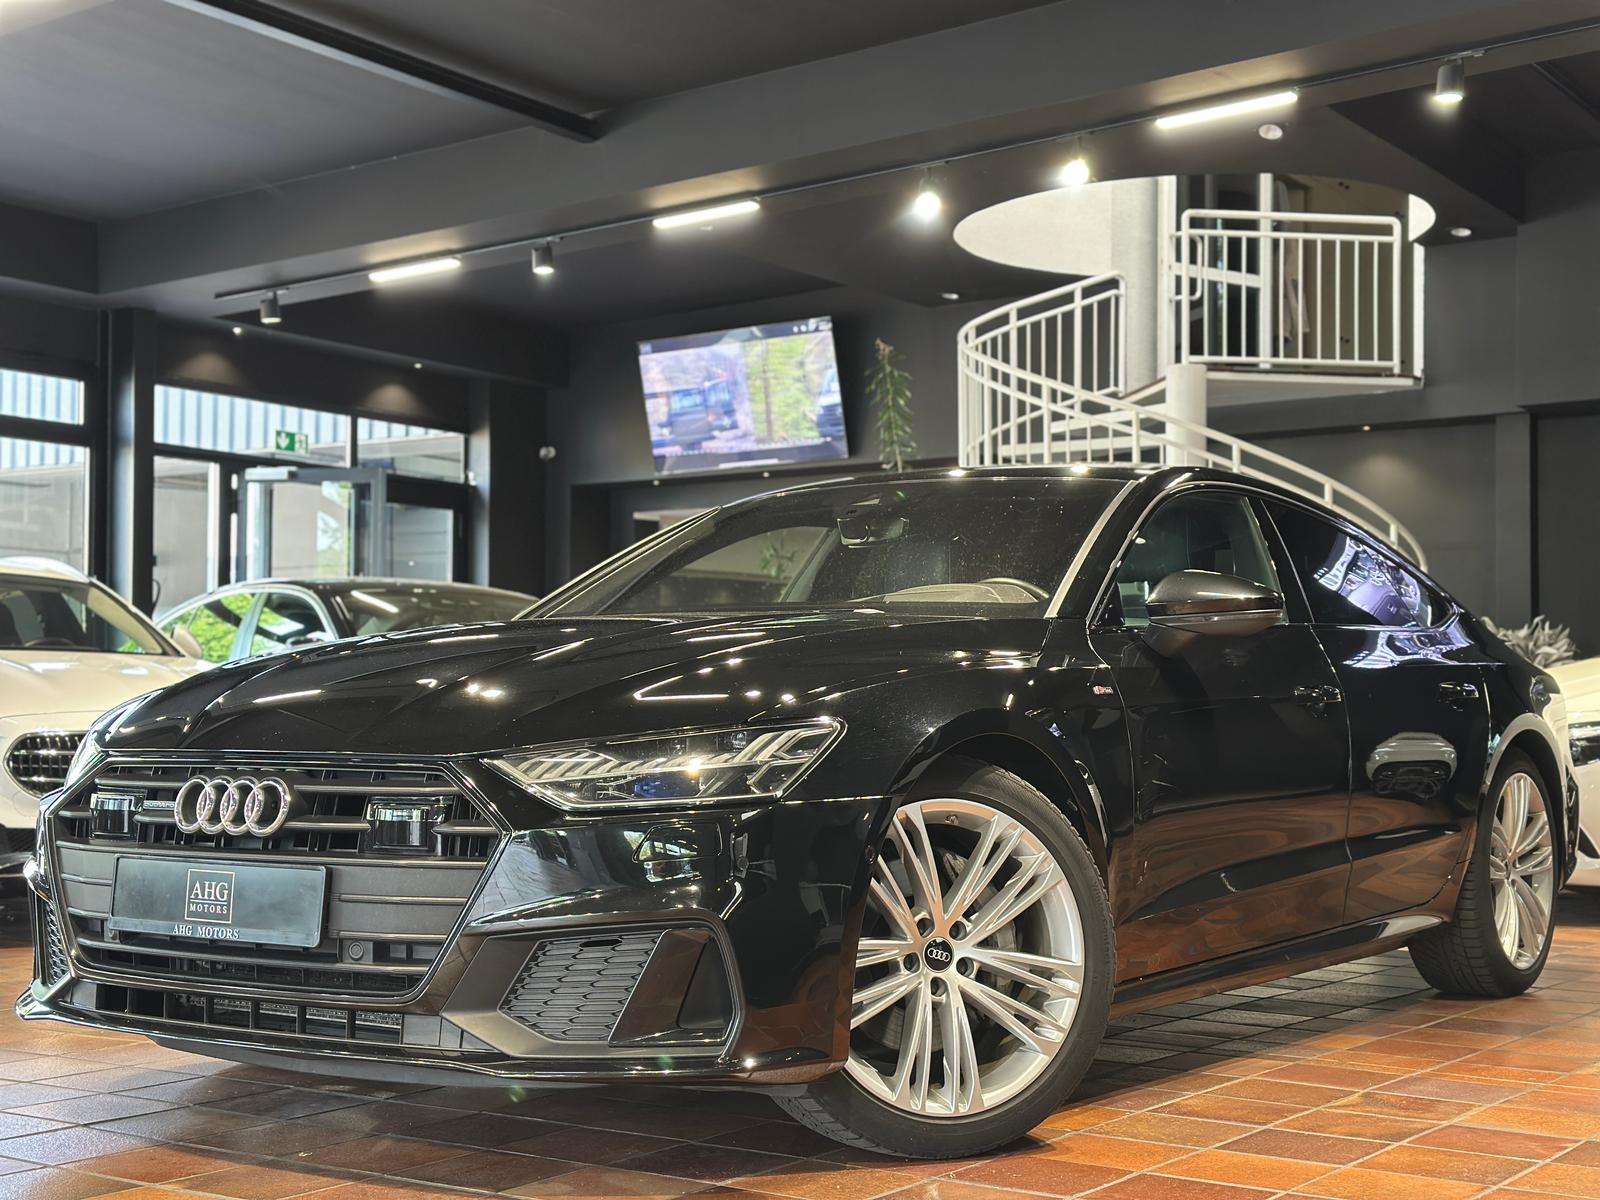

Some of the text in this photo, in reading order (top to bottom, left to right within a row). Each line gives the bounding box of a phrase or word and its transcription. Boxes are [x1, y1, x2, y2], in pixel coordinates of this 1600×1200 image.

[190, 880, 229, 901] AHG
[189, 903, 228, 914] MOTORS
[172, 924, 239, 940] AHG MOTORS
